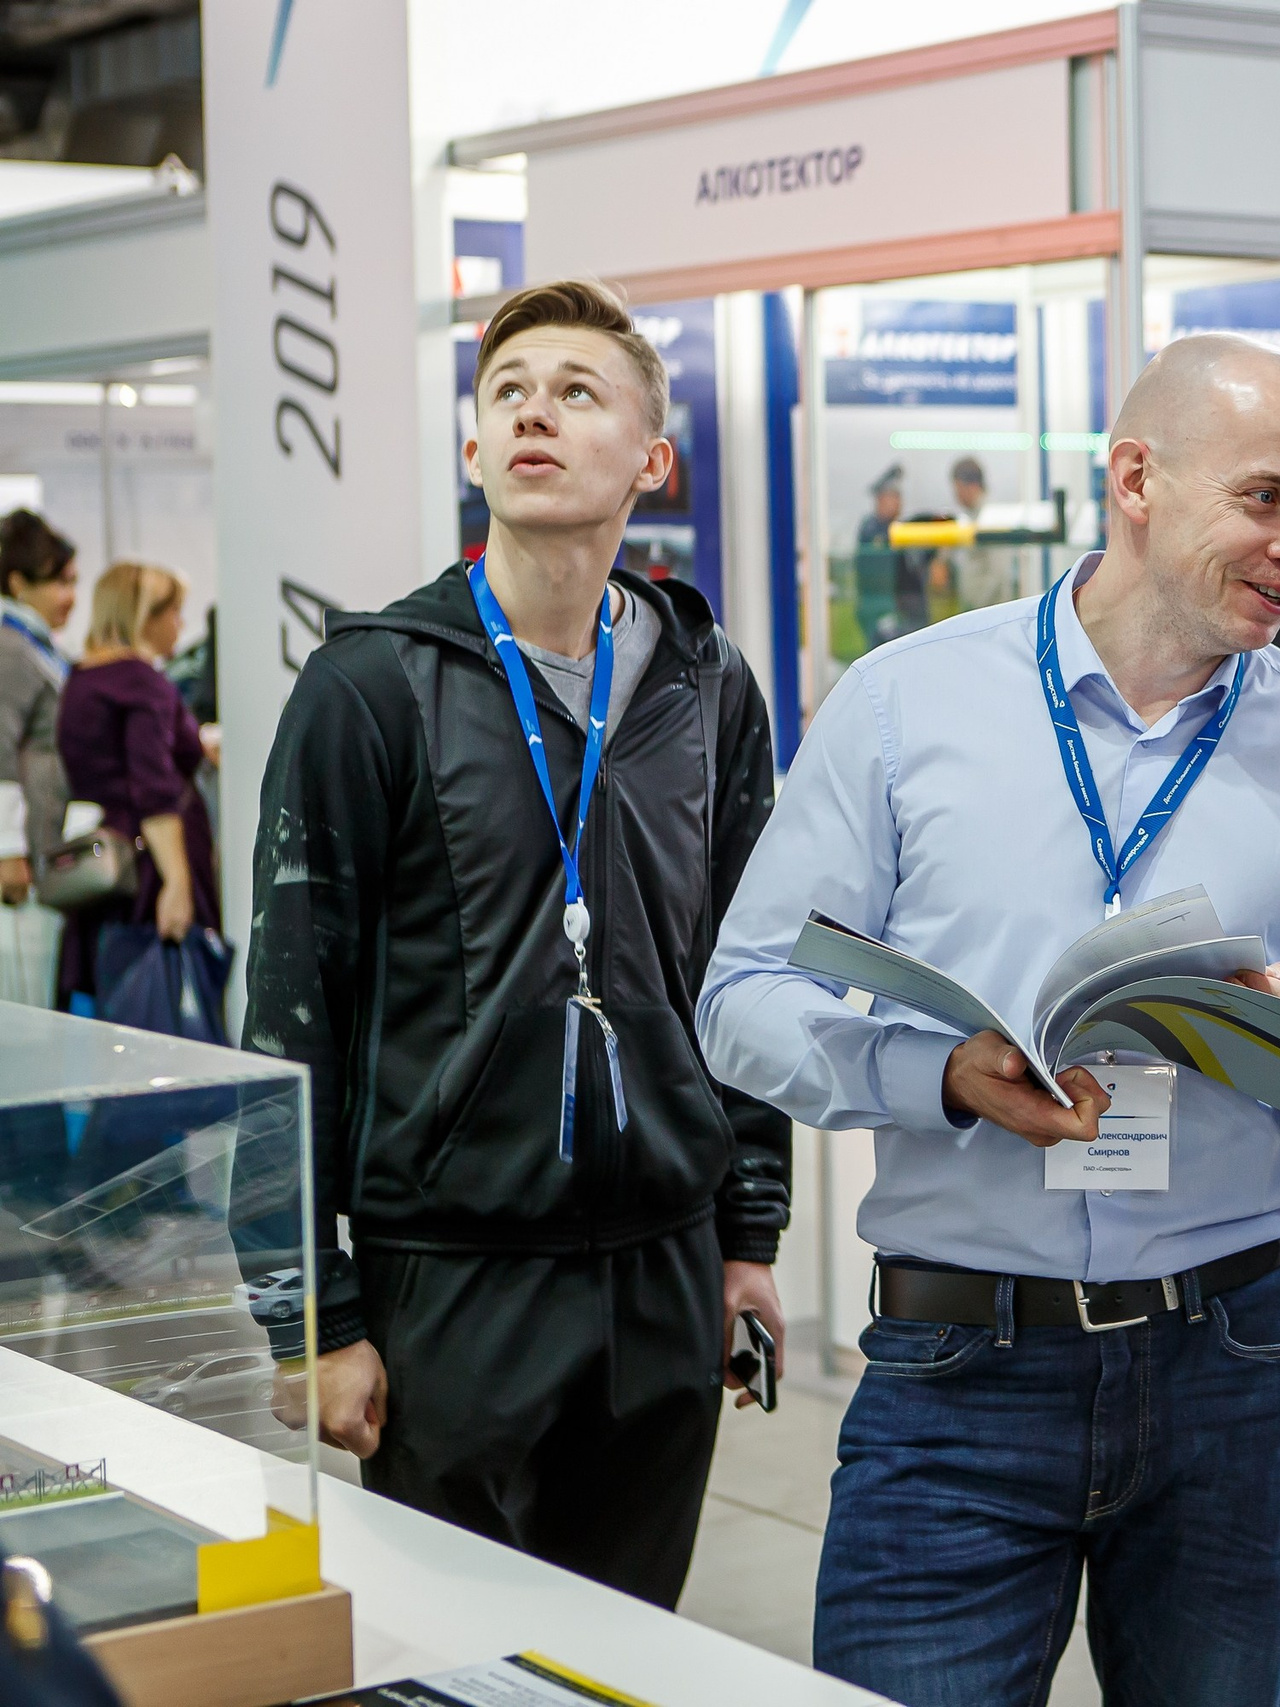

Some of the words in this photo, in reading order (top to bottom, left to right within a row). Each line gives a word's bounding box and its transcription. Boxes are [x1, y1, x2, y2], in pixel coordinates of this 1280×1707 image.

[696, 142, 863, 205] АЛКОТЕКТОР
[269, 181, 341, 481] 2019
[1087, 1147, 1130, 1158] Смирнов
